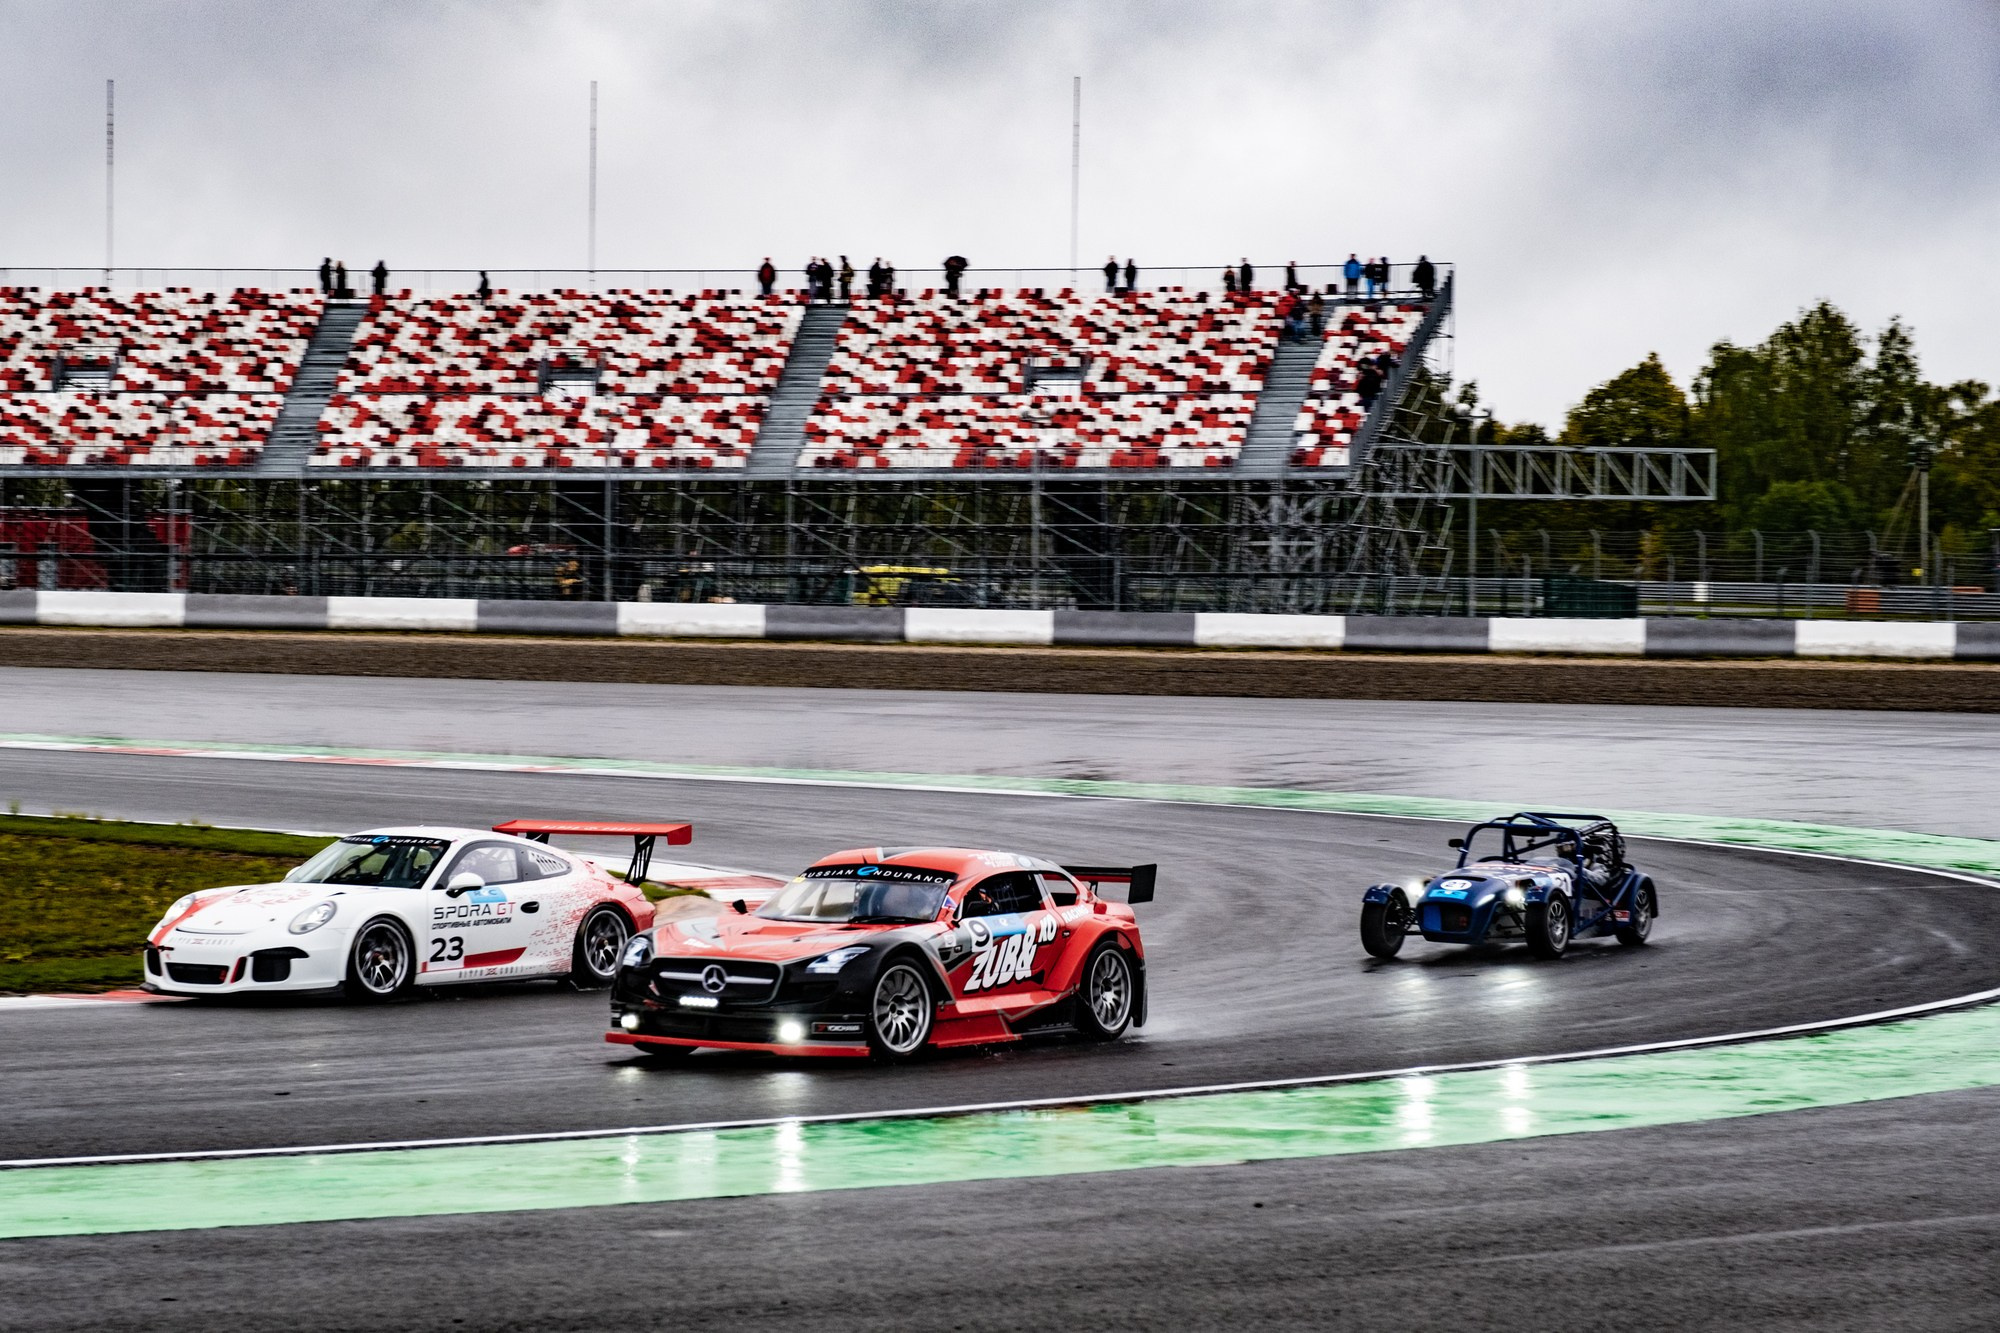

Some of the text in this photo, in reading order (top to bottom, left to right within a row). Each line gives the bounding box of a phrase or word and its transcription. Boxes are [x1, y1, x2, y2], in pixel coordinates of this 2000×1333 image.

[799, 868, 854, 879] RUSSIAN
[433, 902, 517, 920] SPORA GT
[968, 920, 991, 948] 9
[430, 935, 464, 963] 23
